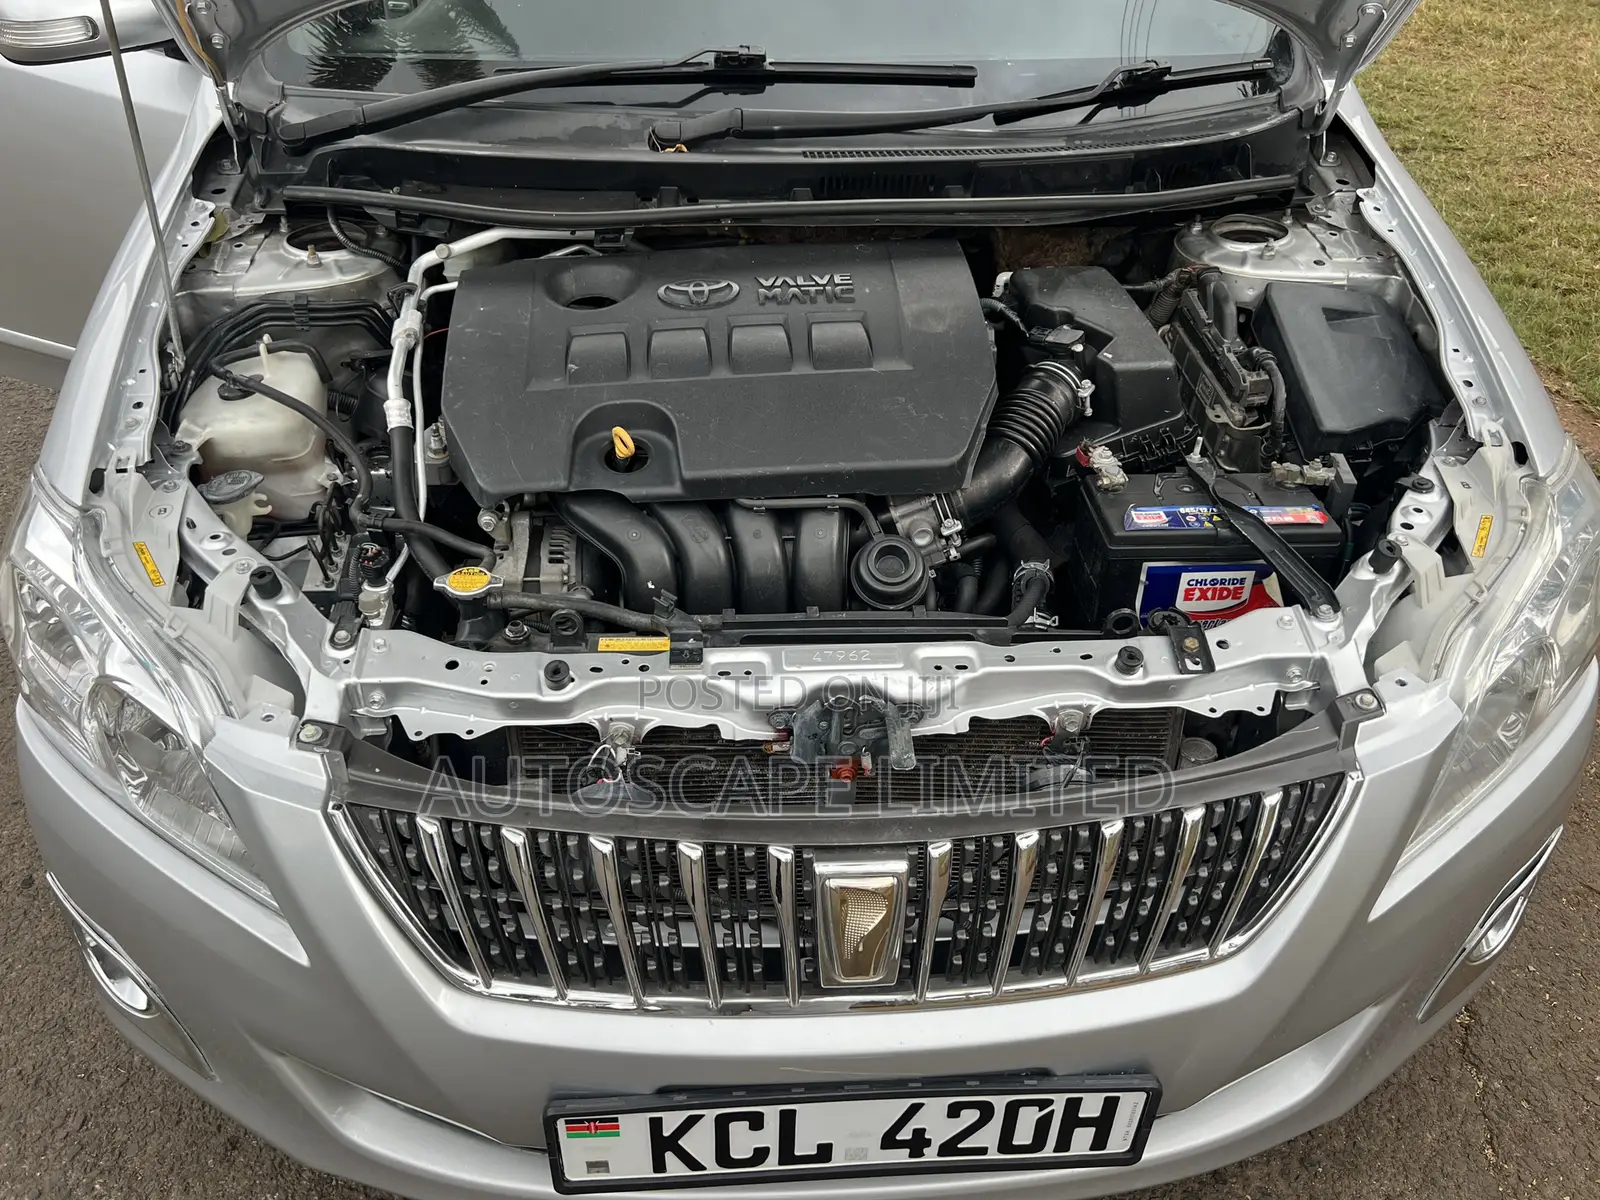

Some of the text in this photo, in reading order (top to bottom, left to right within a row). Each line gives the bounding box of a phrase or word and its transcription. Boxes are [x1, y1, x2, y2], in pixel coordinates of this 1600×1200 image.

[755, 273, 853, 287] VALVE
[758, 286, 855, 306] MATIC
[1186, 577, 1247, 587] CHLORIDE
[1183, 585, 1246, 602] EXIDE
[812, 650, 871, 662] 47962
[648, 1108, 834, 1174] KCL
[880, 1095, 1121, 1158] 420H
